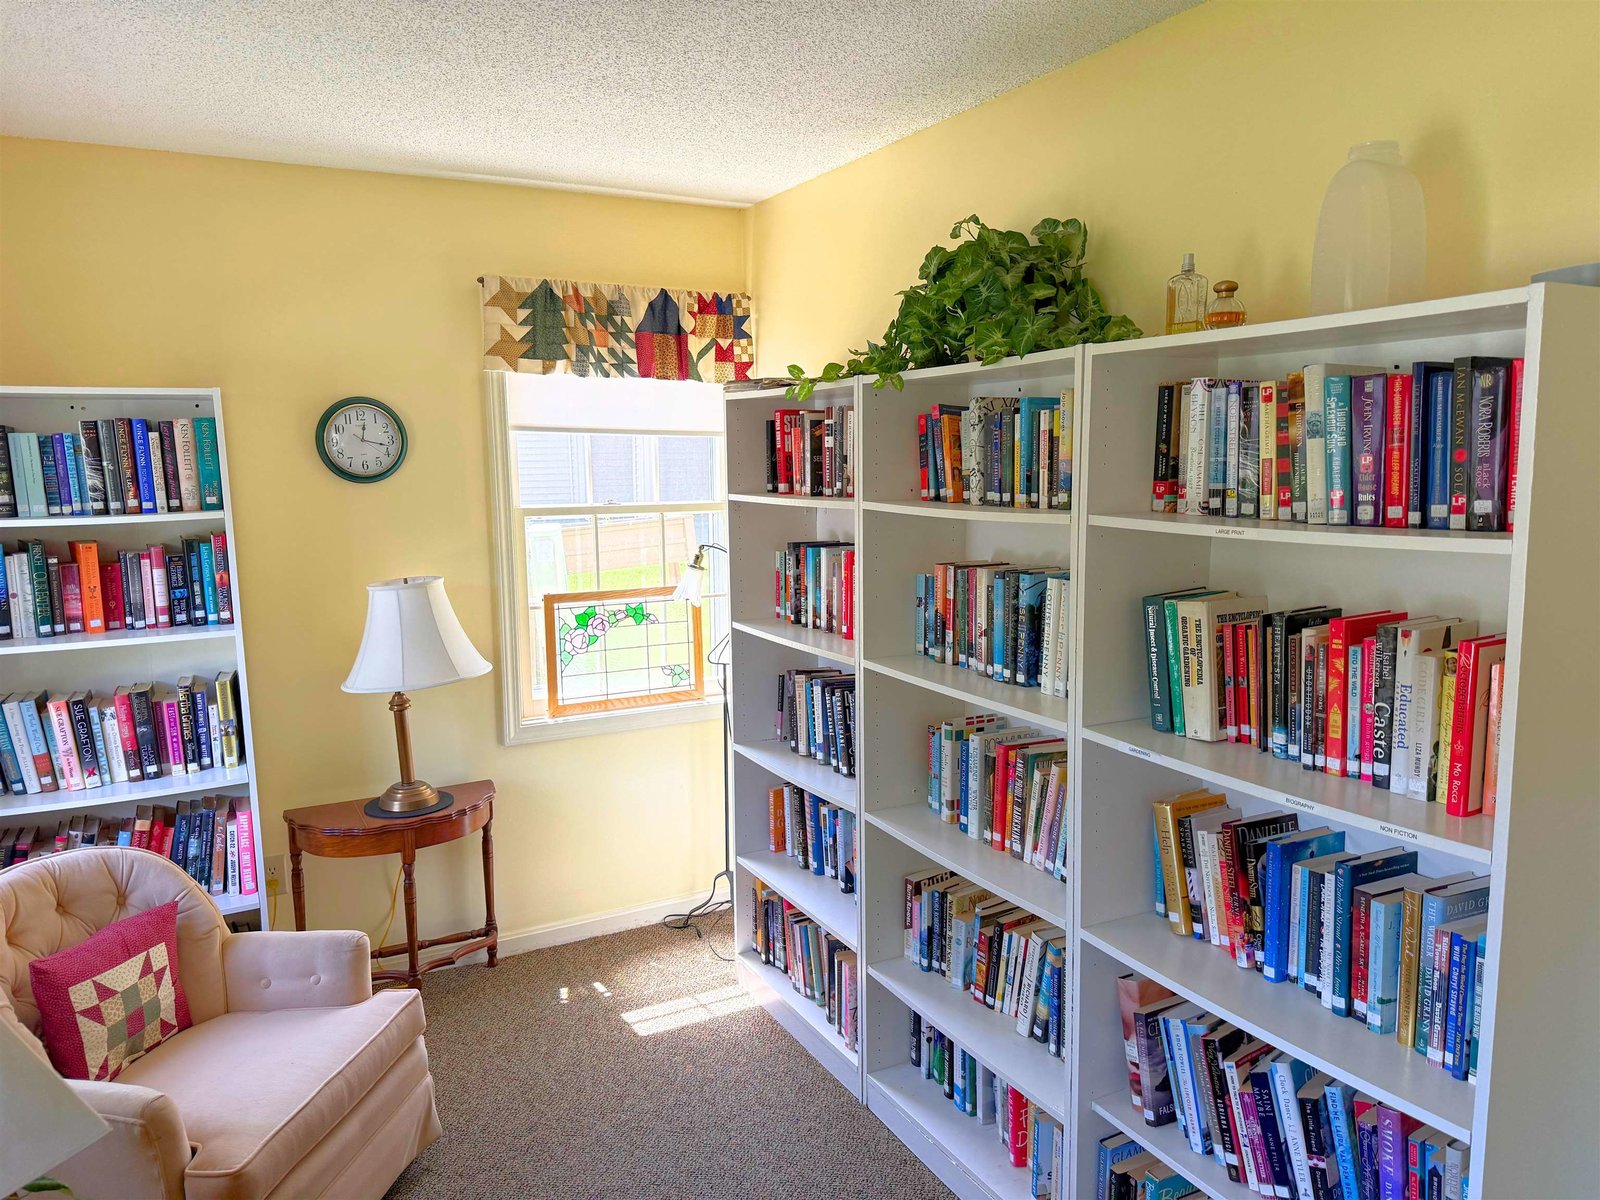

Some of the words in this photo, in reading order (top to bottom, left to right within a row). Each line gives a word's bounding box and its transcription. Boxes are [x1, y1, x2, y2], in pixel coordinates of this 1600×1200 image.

[1457, 367, 1466, 388] IAN
[344, 414, 352, 424] 11
[356, 410, 366, 421] 12
[374, 413, 378, 424] 1
[1190, 393, 1198, 434] BRYSON
[1229, 400, 1238, 424] NOEL
[1326, 397, 1337, 432] SPLENDID
[1362, 395, 1374, 421] JOHN
[1394, 394, 1402, 426] JOHANSEN
[1456, 393, 1465, 444] McEWAN
[1478, 396, 1494, 421] NORA
[180, 423, 189, 438] KEN
[201, 422, 209, 437] KEN
[334, 424, 344, 434] 10
[382, 422, 390, 434] 2
[1296, 403, 1304, 448] UNBROKEN
[1337, 407, 1348, 446] THOUSAND
[332, 436, 338, 447] 9
[388, 435, 395, 446] 3
[1228, 428, 1236, 458] STREET
[1328, 434, 1338, 454] SUNS
[1363, 425, 1374, 456] IRVING
[1476, 422, 1494, 458] ROBERTS
[64, 434, 77, 479] STARFISH
[121, 445, 130, 468] FLYNN
[182, 441, 193, 473] FOLLETT
[204, 440, 213, 470] FOLLETT
[337, 448, 344, 459] 8
[347, 456, 354, 468] 7
[376, 456, 382, 467] 5
[384, 447, 391, 458] 4
[362, 460, 369, 470] 6
[1454, 467, 1464, 496] SOLA
[1280, 492, 1291, 500] LP
[1358, 493, 1376, 502] Rules
[1452, 497, 1466, 506] LP
[215, 536, 223, 547] TESS
[33, 545, 43, 566] FRENCH
[216, 548, 224, 574] GERRITSEN
[34, 572, 47, 592] OUR
[36, 592, 50, 618] FATHER
[1148, 605, 1156, 628] Natural
[1149, 629, 1157, 646] Insect
[1181, 616, 1189, 646] ORGANIC
[1190, 648, 1196, 657] OF
[1150, 653, 1158, 676] Disease
[1182, 647, 1190, 688] GARDENING
[1382, 652, 1392, 679] Isabel
[1152, 678, 1160, 699] Control
[1416, 661, 1428, 694] CODE
[55, 706, 64, 716] SUE
[74, 704, 84, 721] SUE
[178, 688, 190, 714] Martha
[197, 694, 205, 710] MARTHA
[1398, 683, 1412, 750] Educated
[1416, 697, 1427, 734] GIRLS
[56, 716, 70, 746] GRAFTON
[182, 715, 192, 740] Grimes
[1374, 702, 1392, 758] Caste
[77, 722, 92, 762] GRAFTON
[1415, 742, 1423, 756] LIZA
[1454, 762, 1462, 777] Mo
[1014, 780, 1023, 803] PROULX
[1452, 780, 1460, 803] Rocca
[1286, 798, 1314, 810] BIOGRAPHY
[240, 815, 248, 832] HAPPY
[1012, 806, 1022, 844] BARKSKINS
[1236, 820, 1295, 844] DANIELLE
[1380, 825, 1393, 834] NON
[1394, 828, 1418, 840] FICTION
[242, 833, 250, 848] PLACE
[1161, 830, 1171, 854] Help
[1184, 822, 1194, 866] NICHOLAS
[1222, 829, 1234, 866] DANIELLE
[242, 852, 252, 867] EMILY
[1226, 867, 1236, 889] STEEL
[1336, 876, 1345, 914] Elizabeth
[1232, 892, 1240, 925] TURNING
[1428, 902, 1436, 922] THE
[1447, 900, 1474, 914] DAVID
[1426, 925, 1436, 958] WAGER
[1434, 944, 1442, 969] Flower
[1424, 967, 1434, 996] DAVID
[1452, 967, 1460, 988] Cheryl
[1022, 983, 1032, 1014] RICHARD
[1403, 988, 1412, 1026] ANDREWS
[1450, 990, 1458, 1016] Strayed
[1423, 999, 1432, 1033] GRANN
[1434, 1002, 1442, 1023] David
[1432, 1024, 1440, 1048] Grann
[1252, 1086, 1266, 1118] MAYBE
[1262, 1089, 1273, 1117] SAINT
[1329, 1091, 1338, 1108] FIND
[1216, 1098, 1228, 1129] ADRIANA
[1332, 1110, 1340, 1120] ME
[1278, 1074, 1287, 1095] Clock
[1283, 1098, 1292, 1121] Dance
[1290, 1136, 1300, 1158] ANNE
[1295, 1160, 1306, 1184] TYLER
[1334, 1125, 1344, 1147] LAURA
[1266, 1132, 1275, 1150] ANNE
[1310, 1132, 1318, 1152] Friend
[1382, 1116, 1394, 1176] SMOKE
[1340, 1150, 1348, 1164] VAN
[1343, 1166, 1351, 1180] DEN
